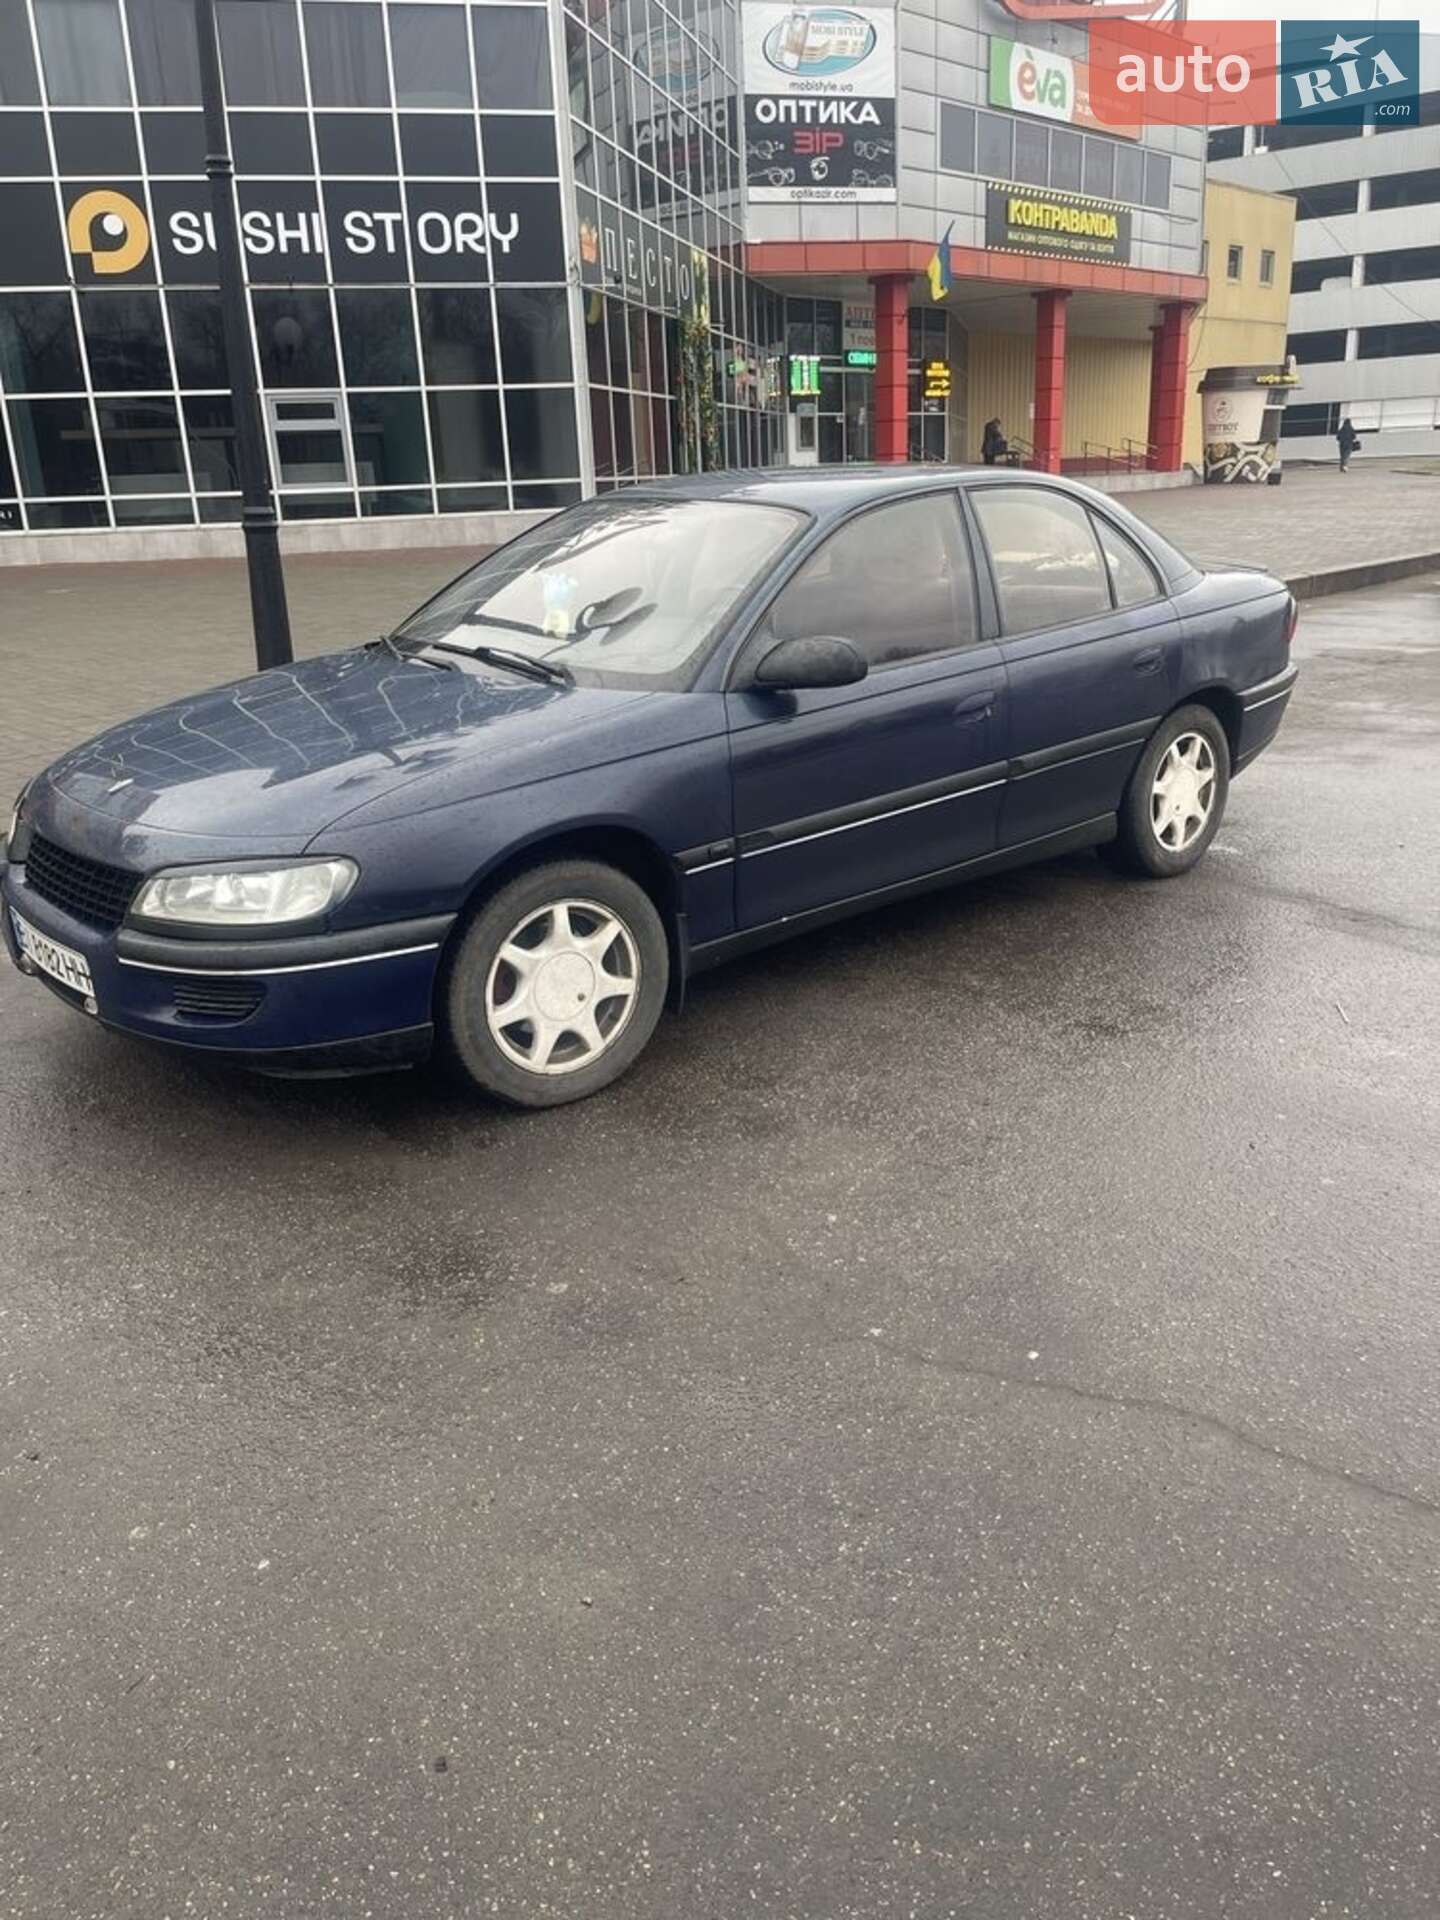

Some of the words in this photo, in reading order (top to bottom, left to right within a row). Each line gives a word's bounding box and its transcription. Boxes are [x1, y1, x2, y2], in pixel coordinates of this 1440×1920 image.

[789, 79, 853, 93] mobistyle.ua
[755, 98, 881, 126] ОПТИКА
[169, 211, 323, 254] SSHI
[343, 211, 519, 254] STORY
[605, 228, 690, 300] ПЕСТО
